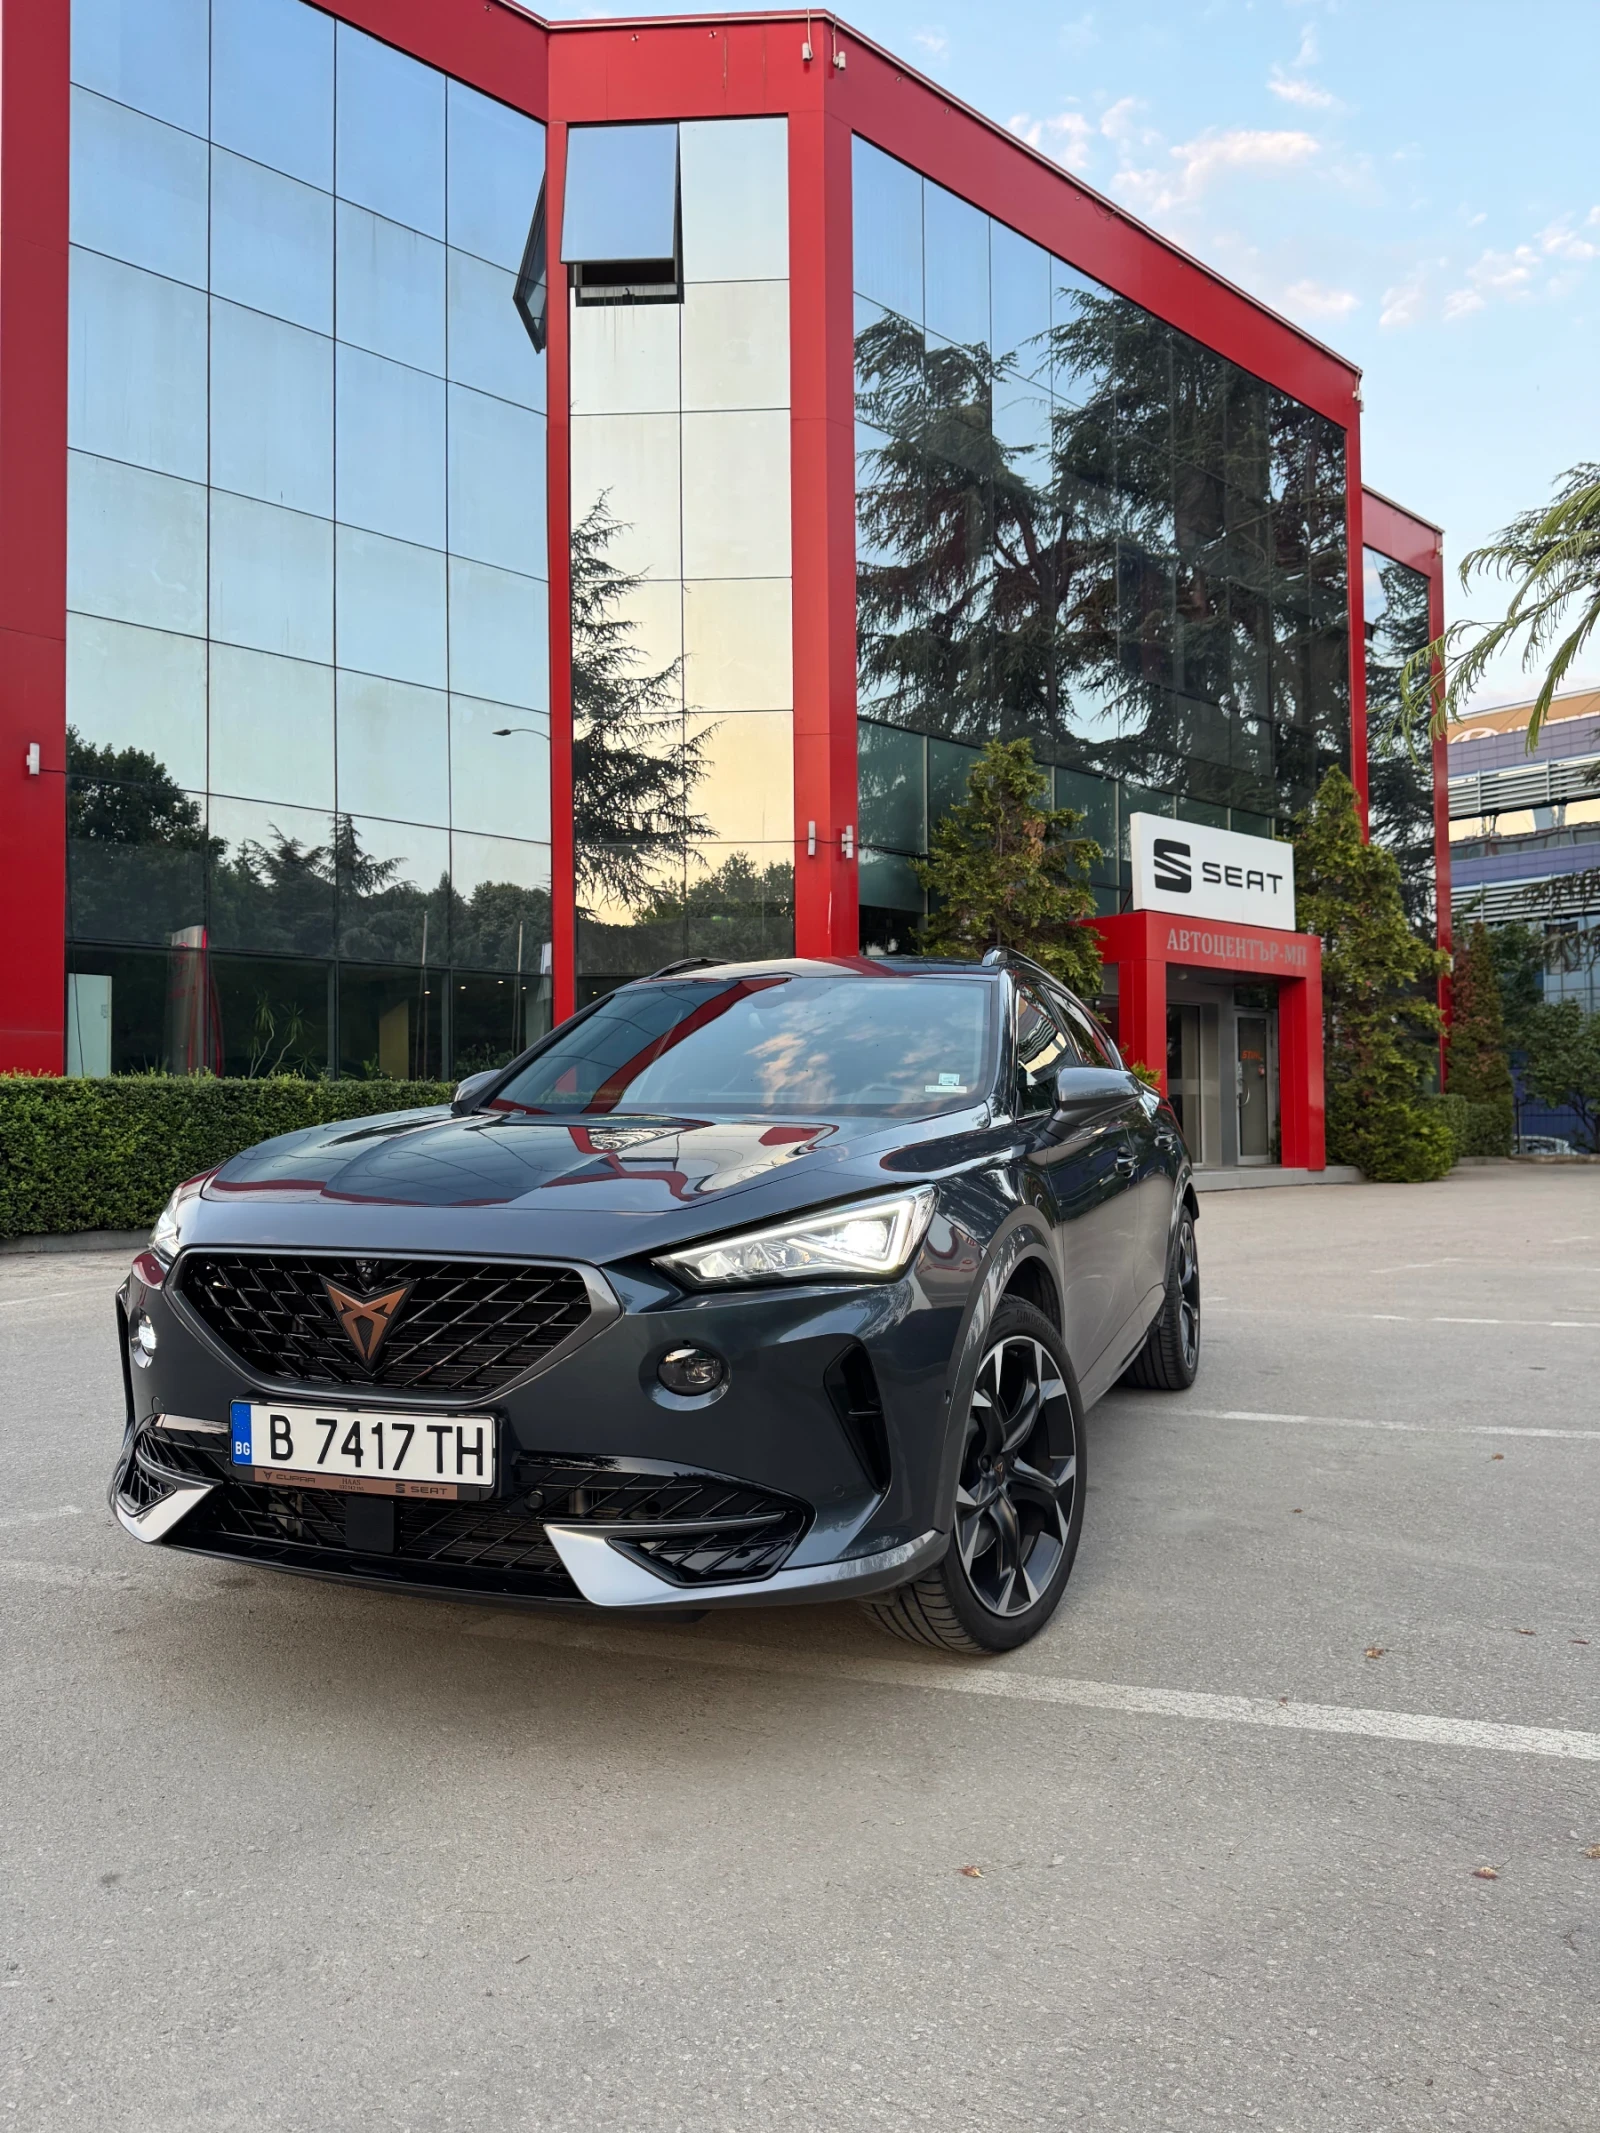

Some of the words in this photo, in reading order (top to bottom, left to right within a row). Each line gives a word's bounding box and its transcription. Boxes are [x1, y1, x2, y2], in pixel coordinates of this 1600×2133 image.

[1202, 861, 1283, 894] SEAT
[235, 1441, 251, 1456] BG
[269, 1413, 294, 1461] B
[315, 1417, 415, 1471] 7417
[426, 1424, 484, 1477] TH
[276, 1473, 316, 1484] CUPRA
[410, 1485, 448, 1496] SEAT
